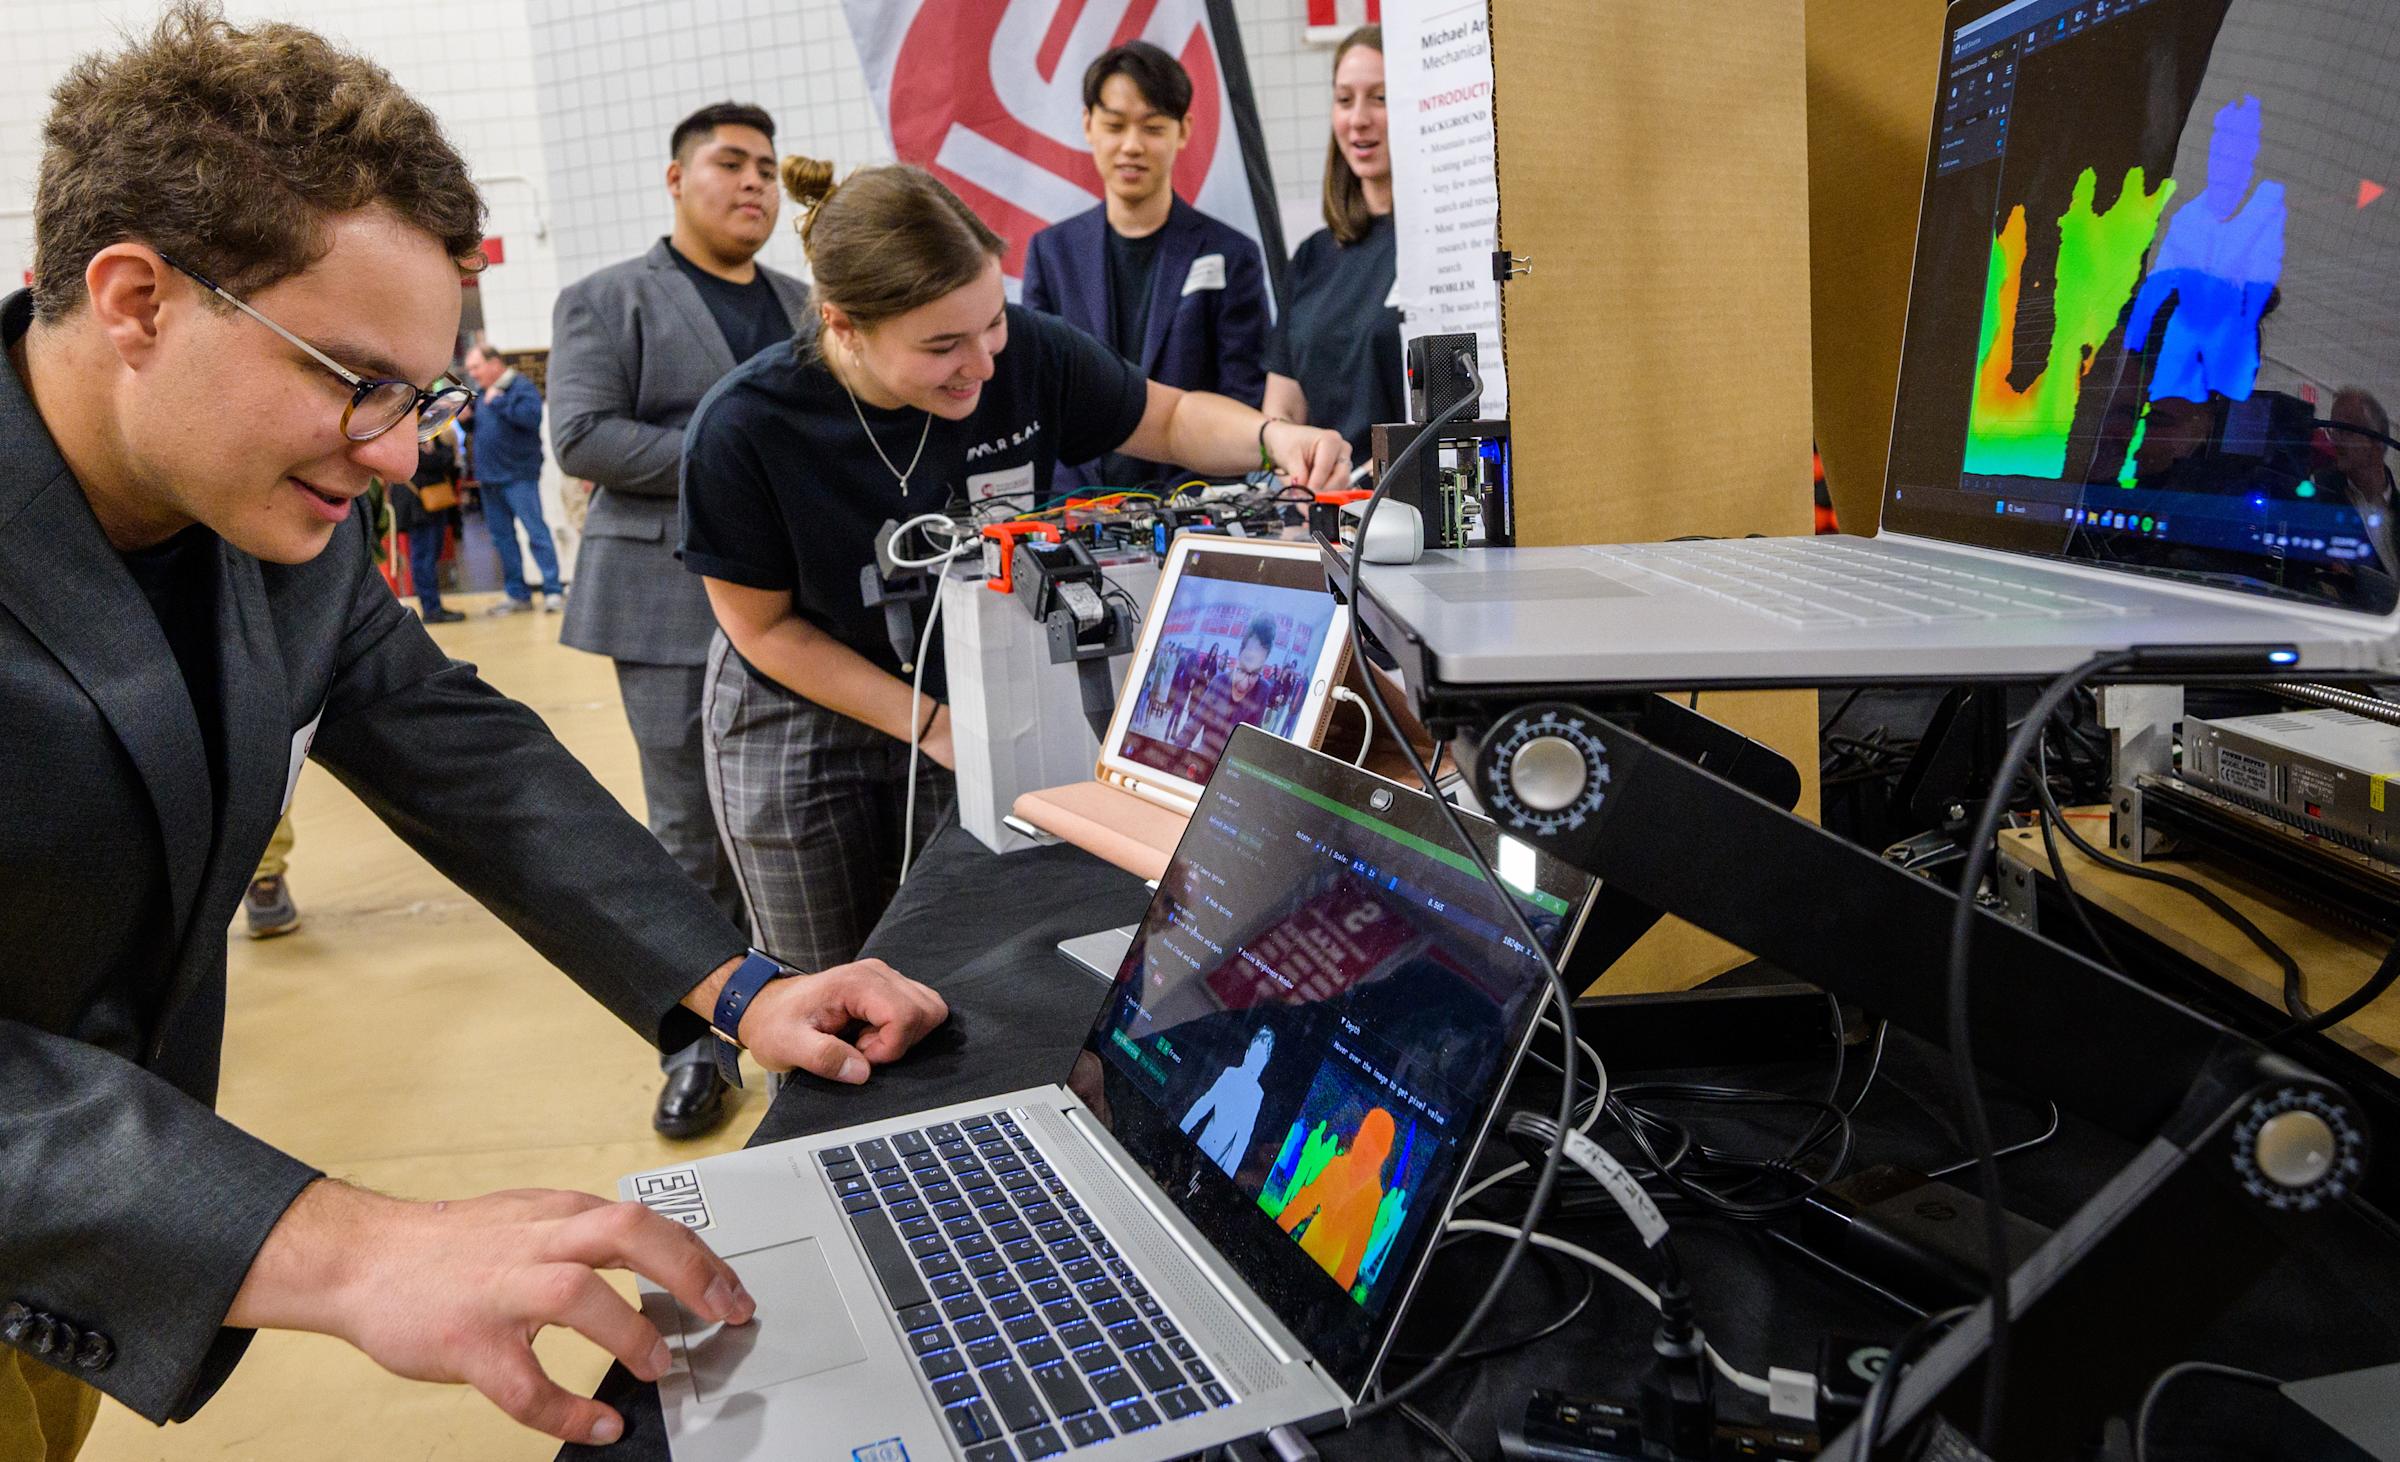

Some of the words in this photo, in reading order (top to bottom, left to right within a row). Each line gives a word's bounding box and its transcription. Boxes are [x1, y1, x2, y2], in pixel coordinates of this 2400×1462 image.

[1421, 22, 1467, 49] Michael
[1472, 19, 1485, 33] Ar
[1422, 40, 1487, 71] Mechanical
[1420, 110, 1487, 136] BACKGROUND
[1463, 156, 1476, 167] and
[1460, 198, 1474, 209] and
[1429, 280, 1475, 295] PROBLEM
[1440, 302, 1454, 314] The
[2222, 750, 2242, 761] POWER
[2243, 756, 2266, 769] SUPPLY
[1295, 830, 1313, 844] Rotate:
[1332, 851, 1349, 865] Scale:
[1353, 861, 1366, 873] 0.5x
[1427, 898, 1445, 912] 0.565
[1241, 950, 1256, 964] Active
[1254, 959, 1278, 980] Brightness
[1278, 974, 1295, 990] Window
[1345, 1020, 1360, 1036] Depth
[1333, 1040, 1348, 1055] Hover
[1348, 1052, 1362, 1064] over
[1362, 1060, 1372, 1073] the
[1372, 1067, 1388, 1085] image
[1396, 1087, 1408, 1100] get
[1407, 1095, 1427, 1112] pixel
[1427, 1108, 1445, 1126] value
